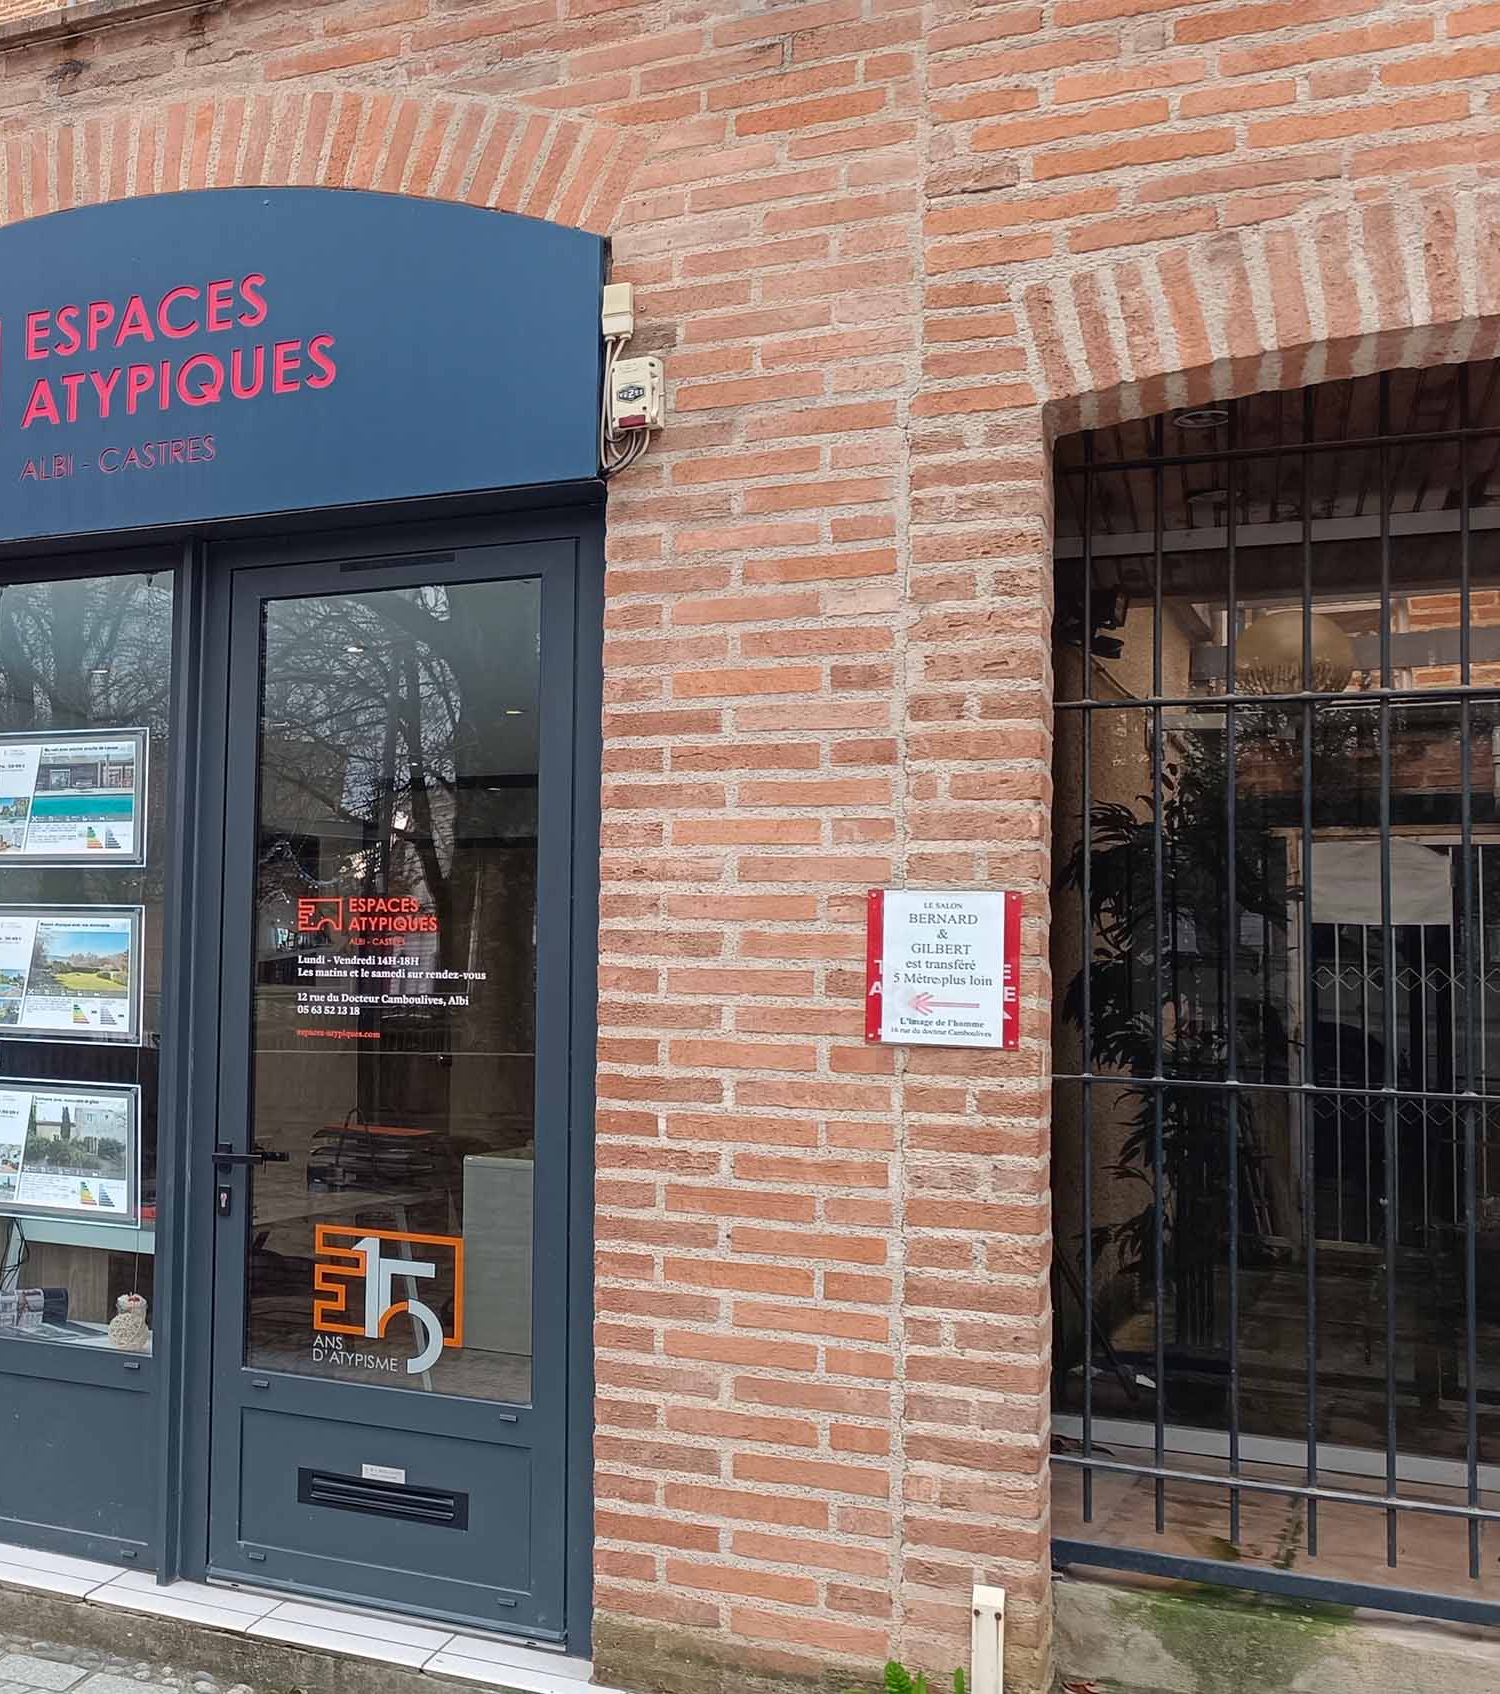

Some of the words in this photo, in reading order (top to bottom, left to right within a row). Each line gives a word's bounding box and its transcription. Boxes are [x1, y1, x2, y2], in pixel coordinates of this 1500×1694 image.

[26, 273, 268, 360] ESPACES
[21, 333, 337, 429] ATYPIQUES
[20, 452, 73, 481] ALBI
[99, 433, 216, 474] CASTRES
[349, 898, 419, 913] ESPACES
[935, 902, 963, 910] SALON
[348, 916, 438, 932] ATYPIQUES
[909, 913, 979, 925] BERNARD
[937, 929, 948, 940] &
[911, 943, 973, 956] GILBERT
[298, 955, 325, 965] Lundi
[333, 955, 376, 965] Vendredi
[905, 960, 922, 969] est
[925, 959, 977, 970] transféré
[297, 967, 314, 977] Les
[315, 967, 348, 977] matins
[349, 969, 359, 977] et
[360, 968, 370, 978] le
[371, 968, 405, 978] samedi
[407, 971, 423, 979] sur
[425, 969, 487, 980] rendez-vous
[893, 973, 901, 983] 5
[941, 974, 966, 988] plus
[969, 975, 993, 986] loin
[297, 992, 308, 1002] 12
[309, 994, 325, 1002] rue
[326, 993, 340, 1002] du
[341, 994, 380, 1004] Docteur
[381, 994, 446, 1007] Camboulives,
[448, 996, 469, 1006] Albi
[297, 1005, 309, 1014] 05
[310, 1005, 322, 1015] 63
[323, 1006, 336, 1015] 52
[337, 1006, 348, 1015] 13
[349, 1006, 360, 1016] 18
[312, 1335, 342, 1350] ANS
[312, 1349, 398, 1372] D'ATYPISME
